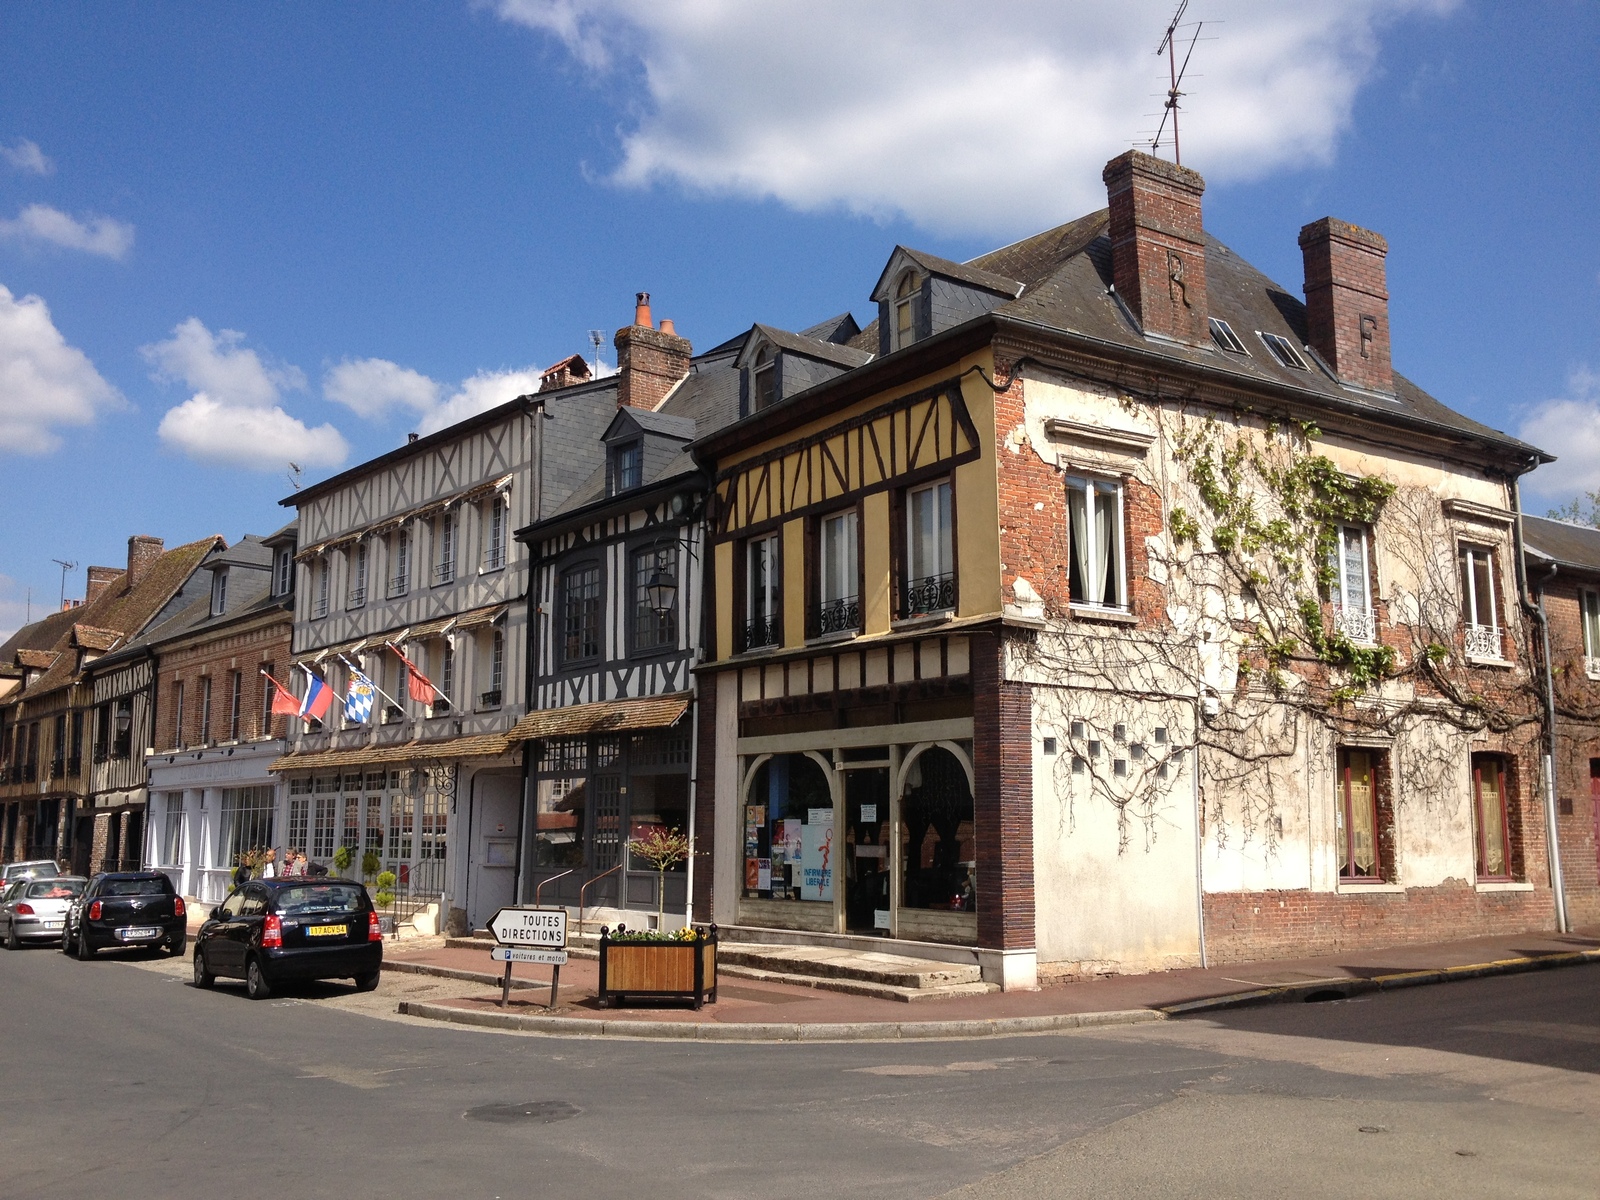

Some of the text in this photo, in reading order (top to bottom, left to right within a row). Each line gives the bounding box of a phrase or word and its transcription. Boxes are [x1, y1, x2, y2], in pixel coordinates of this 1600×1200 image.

[1359, 312, 1377, 358] F
[523, 915, 560, 927] TOUTES
[502, 928, 562, 942] DIRECTIONS
[512, 952, 536, 961] voitures
[546, 955, 565, 963] motos
